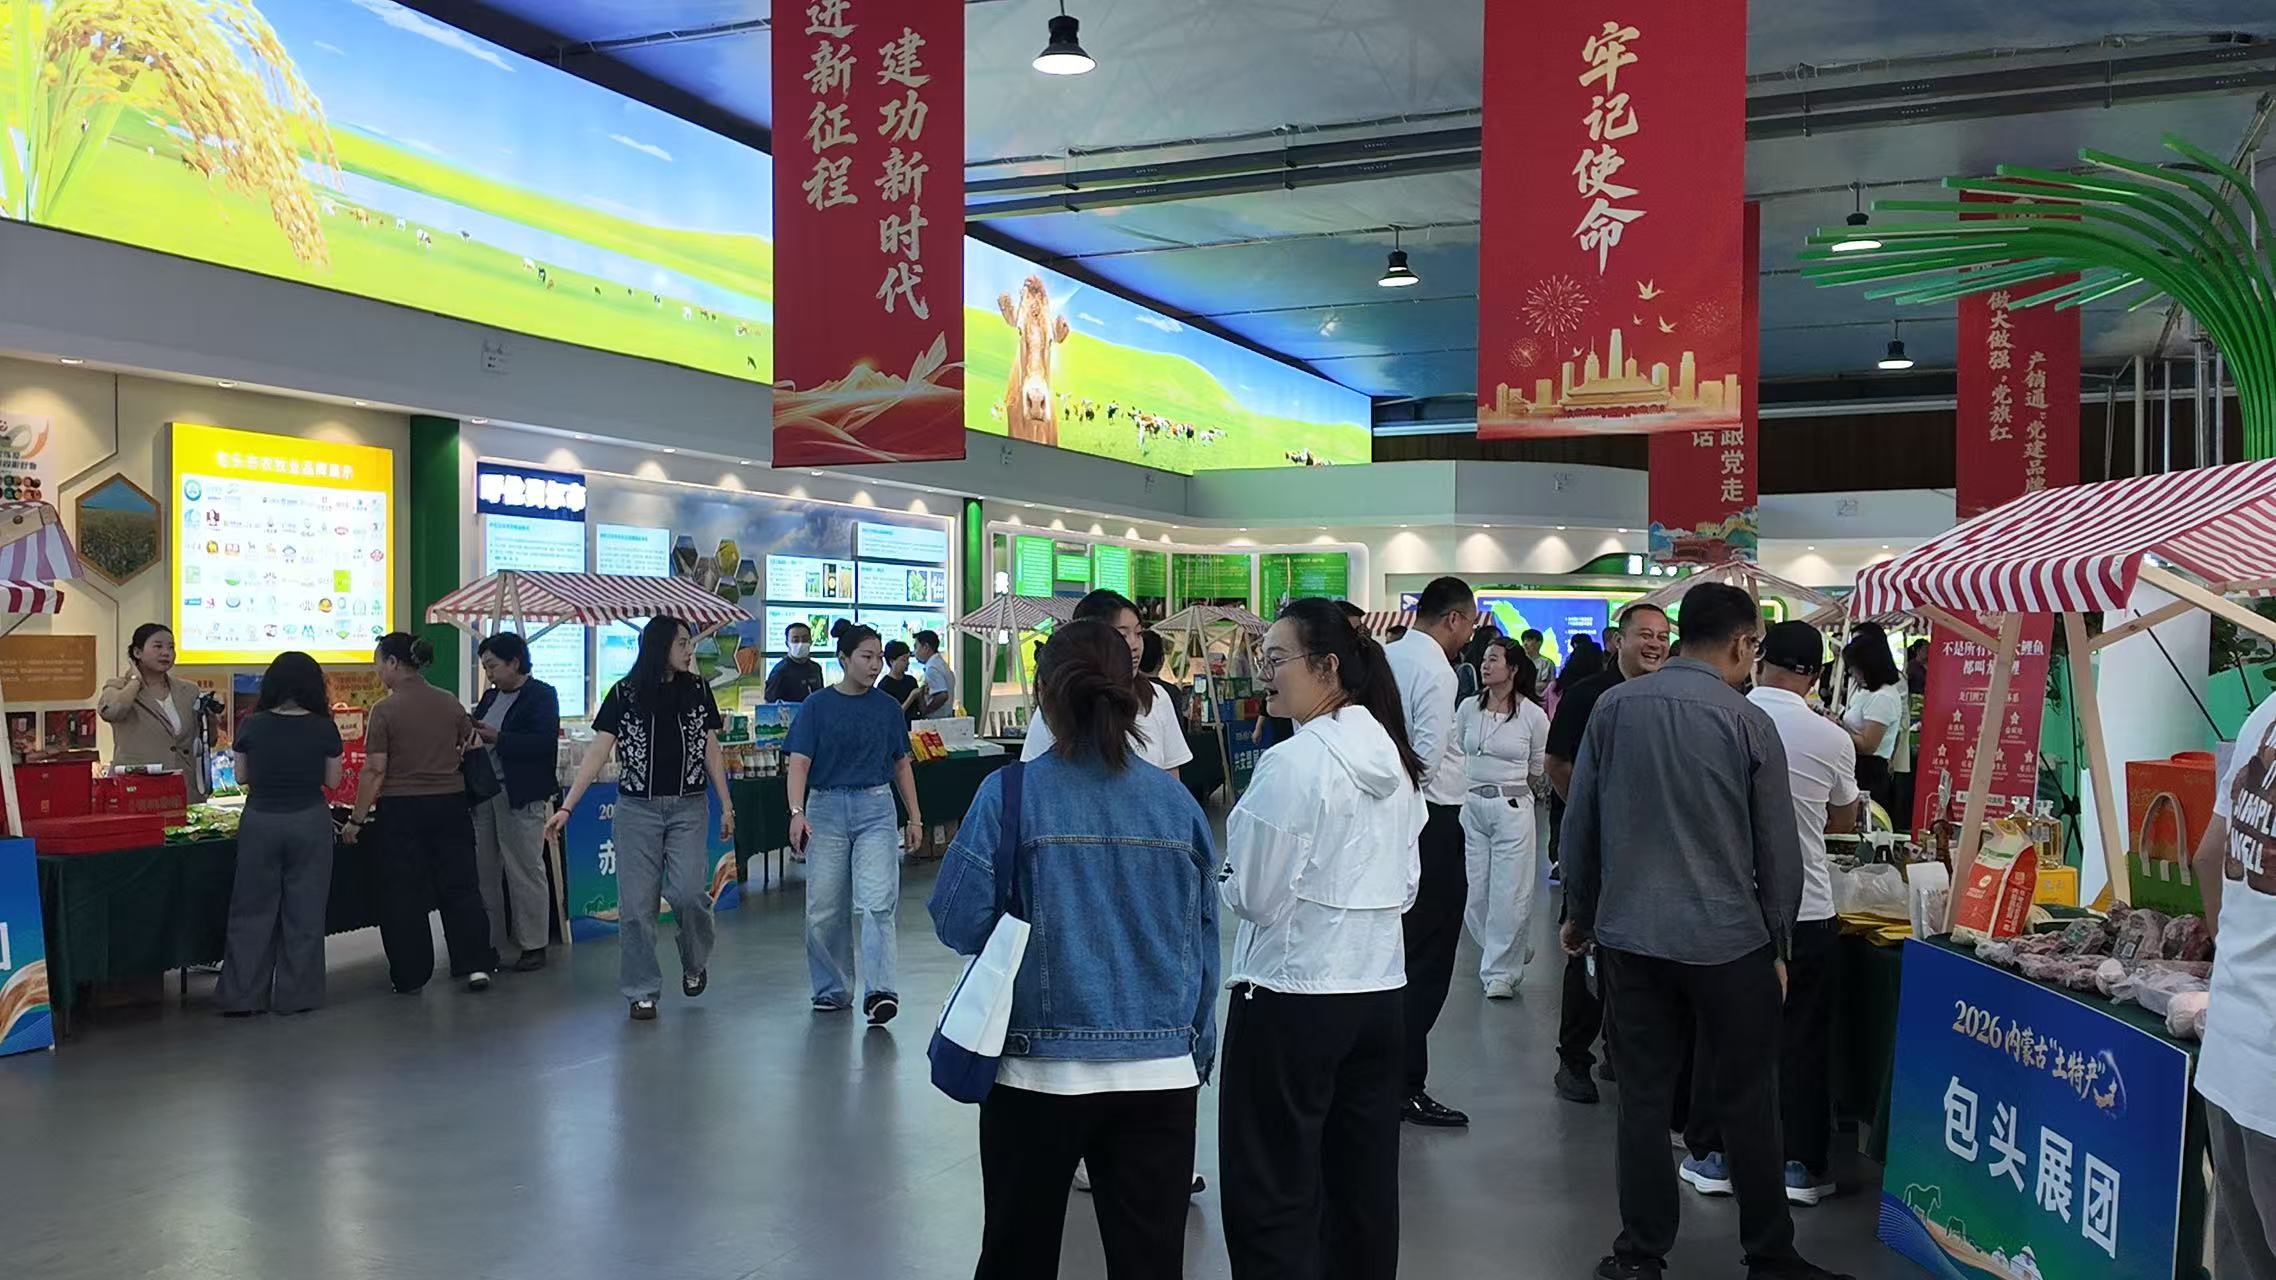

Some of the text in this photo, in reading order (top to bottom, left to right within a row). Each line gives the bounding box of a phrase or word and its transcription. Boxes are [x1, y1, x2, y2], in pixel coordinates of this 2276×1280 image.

[874, 26, 931, 320] 建功新时代
[1571, 20, 1648, 277] 牢记使命
[1720, 421, 1744, 502] 跟党走
[2231, 826, 2264, 876] WELL
[1952, 999, 2003, 1049] 2026
[1943, 1075, 2121, 1260] 包头展团
